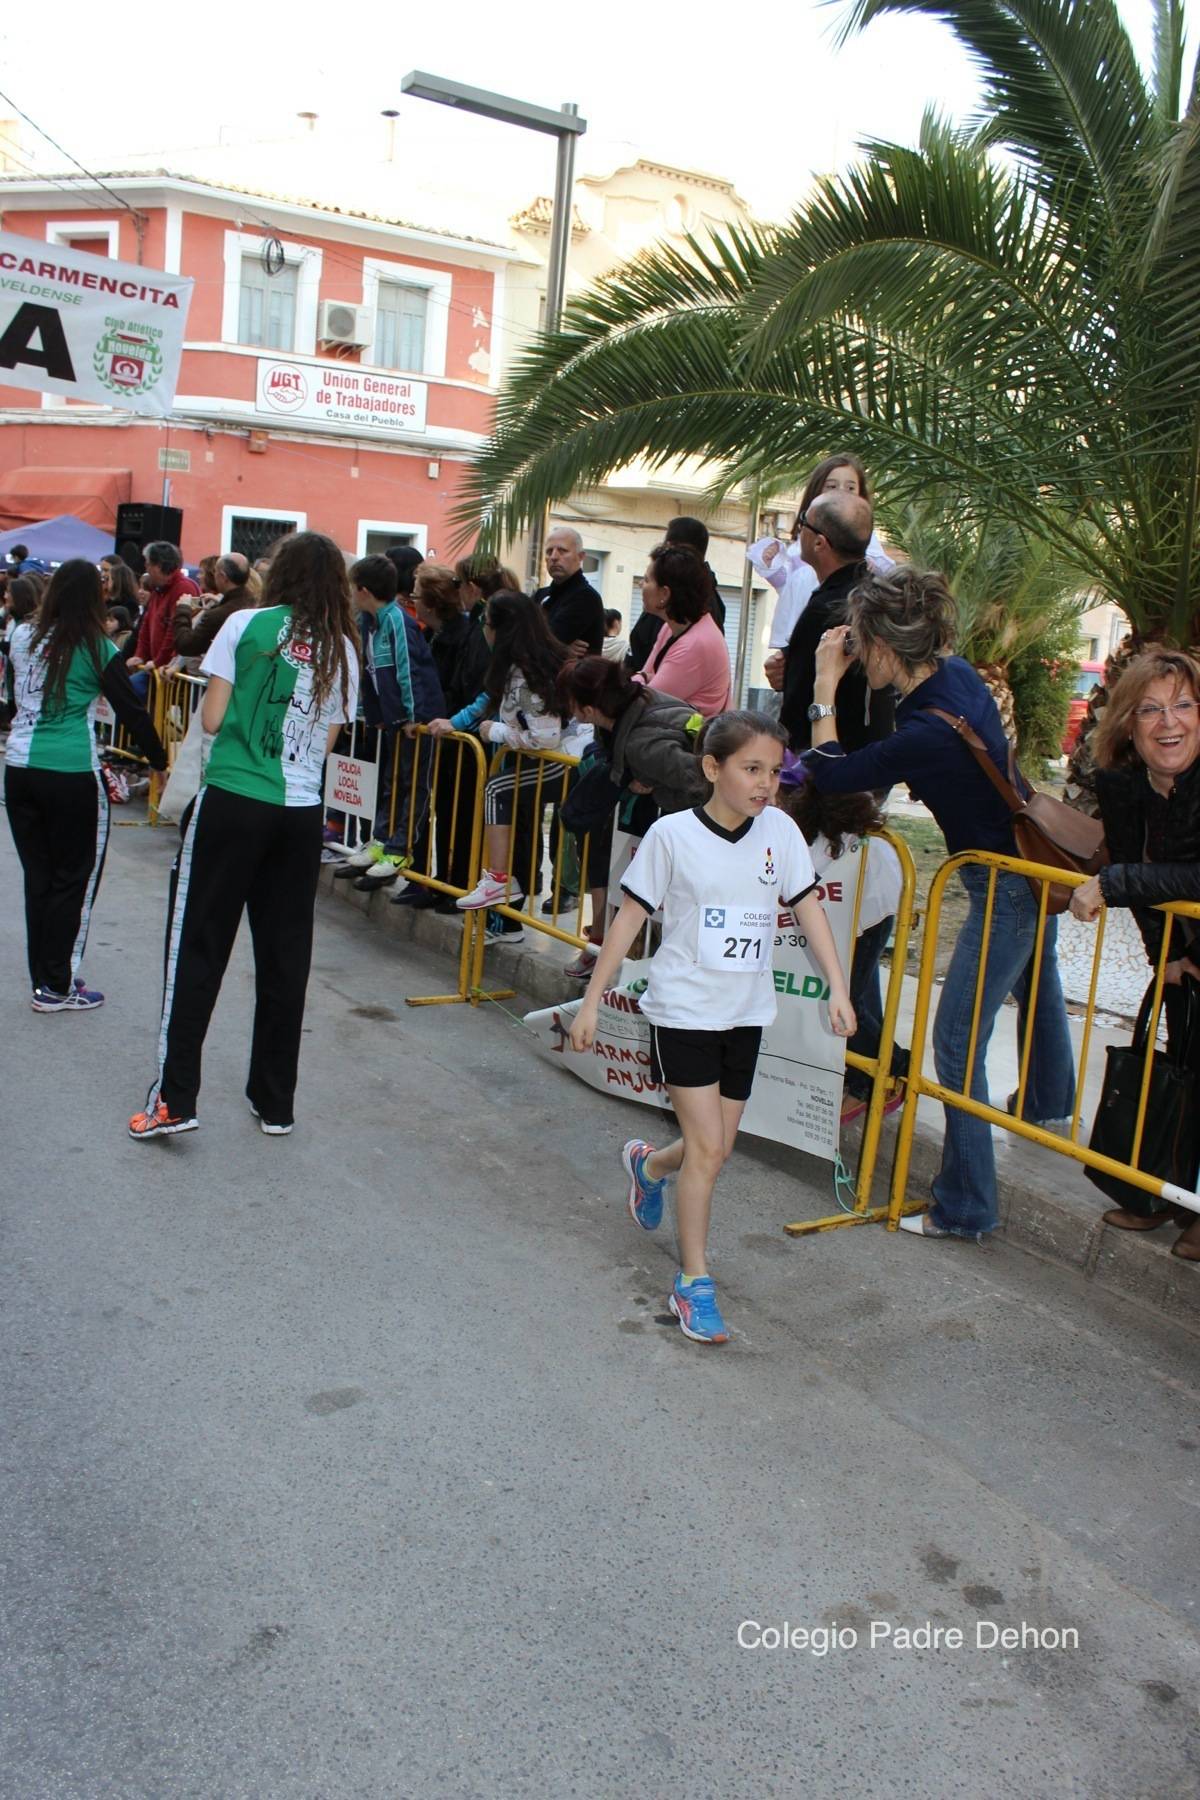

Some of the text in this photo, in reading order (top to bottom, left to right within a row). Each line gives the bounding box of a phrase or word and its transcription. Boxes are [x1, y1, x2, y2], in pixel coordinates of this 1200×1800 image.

[0, 253, 180, 308] CARMENCITA
[0, 302, 77, 382] A
[271, 371, 300, 390] UGT
[363, 378, 411, 397] General
[316, 389, 416, 416] de Trabajadores
[326, 409, 404, 427] Casa del Pueblo
[338, 776, 359, 791] LOCAL
[334, 790, 362, 806] NOVELDA
[723, 937, 762, 960] 271
